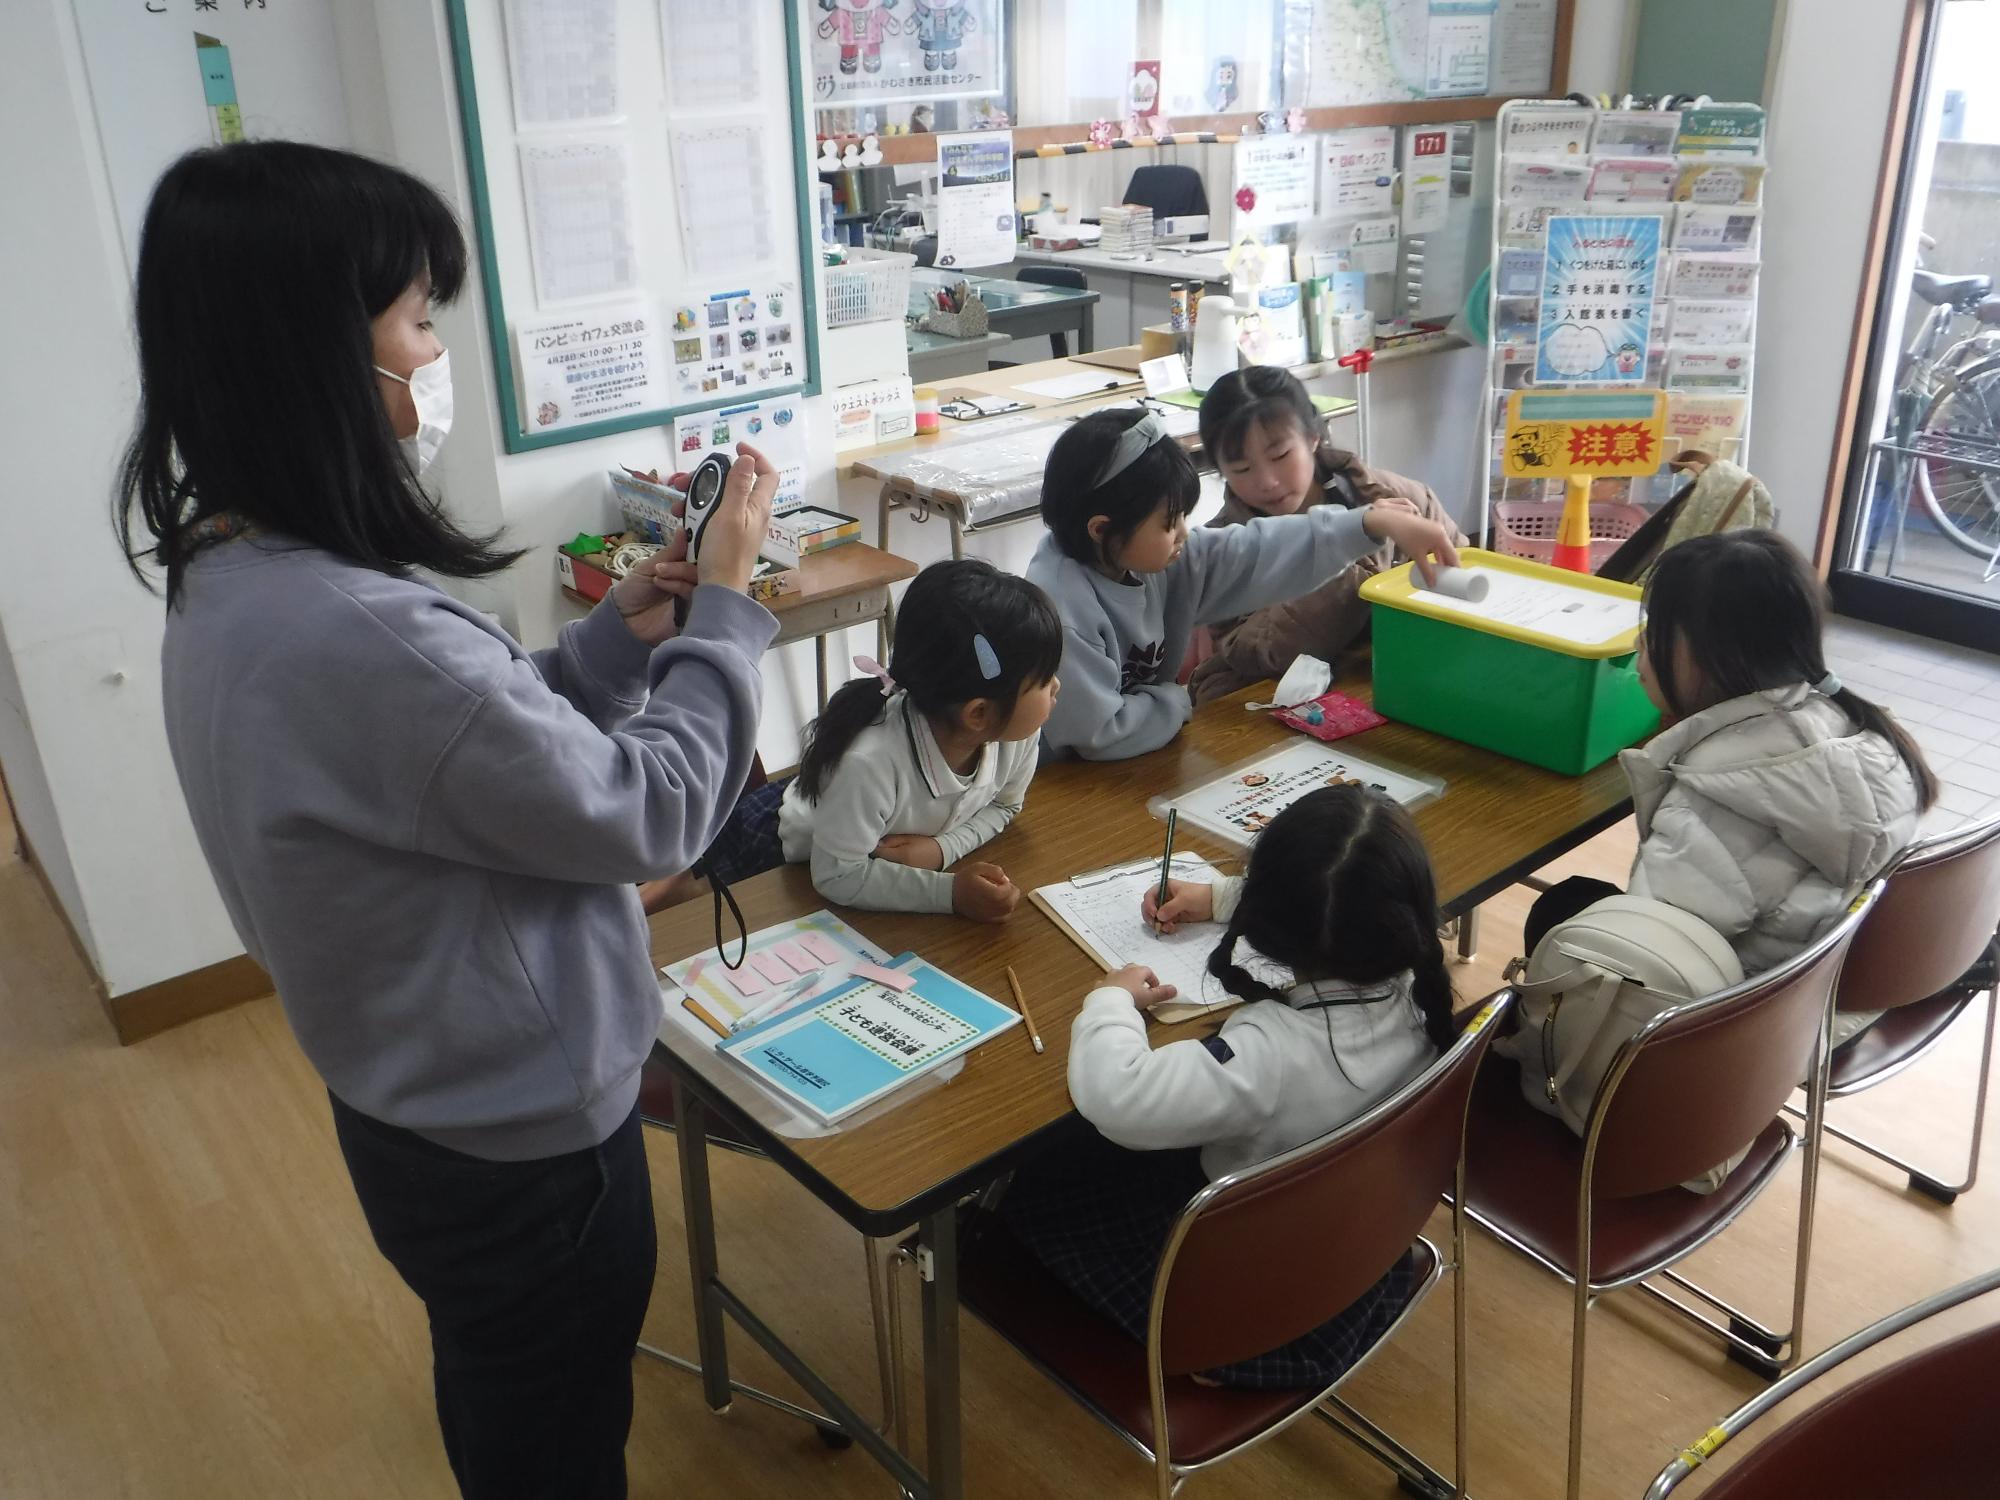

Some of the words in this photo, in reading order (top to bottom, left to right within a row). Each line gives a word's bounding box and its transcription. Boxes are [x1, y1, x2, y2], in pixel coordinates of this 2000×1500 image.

[1418, 135, 1442, 152] 171
[833, 391, 901, 413] リクエストボックス
[1579, 431, 1642, 458] 注意
[877, 992, 948, 1035] 玉川こども文化センター
[838, 1006, 922, 1057] 子ども運営会議
